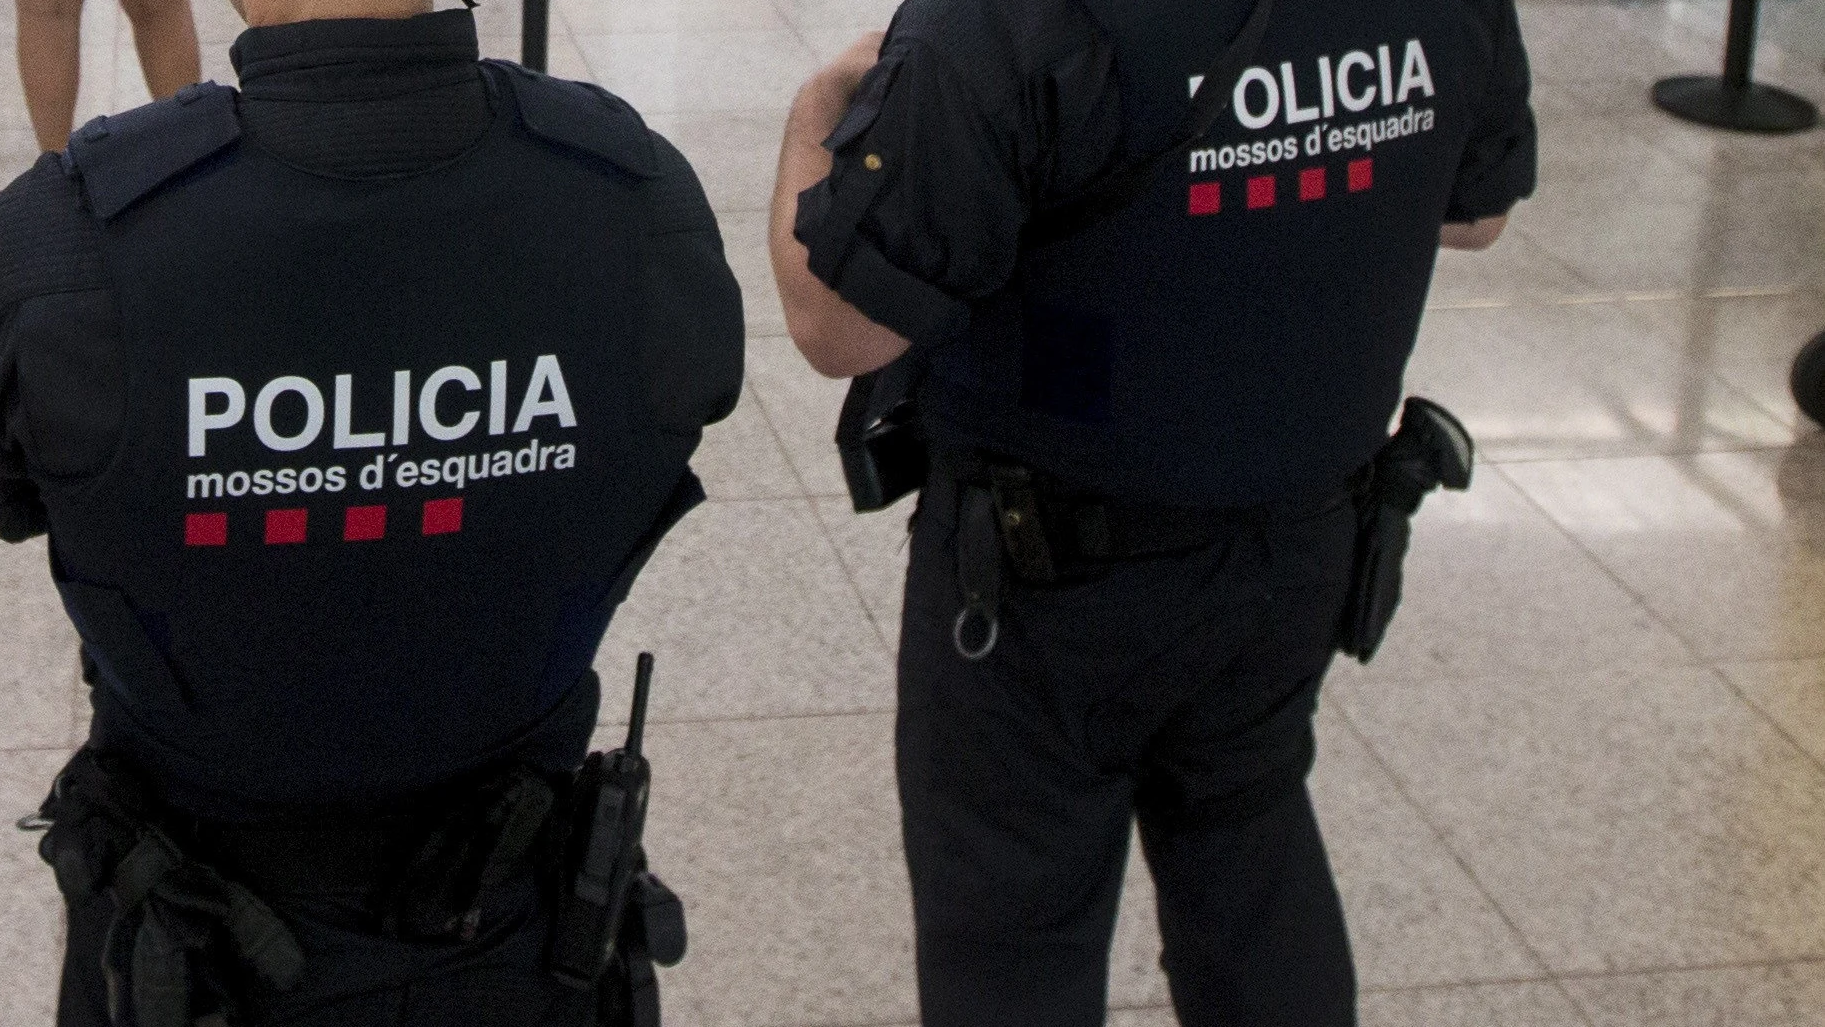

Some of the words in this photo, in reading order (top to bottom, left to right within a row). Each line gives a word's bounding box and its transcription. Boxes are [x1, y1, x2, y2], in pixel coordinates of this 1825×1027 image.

[1188, 39, 1435, 130] OLICIA
[1189, 136, 1299, 173] mossos
[188, 354, 578, 457] POLICIA
[187, 465, 347, 499] mossos
